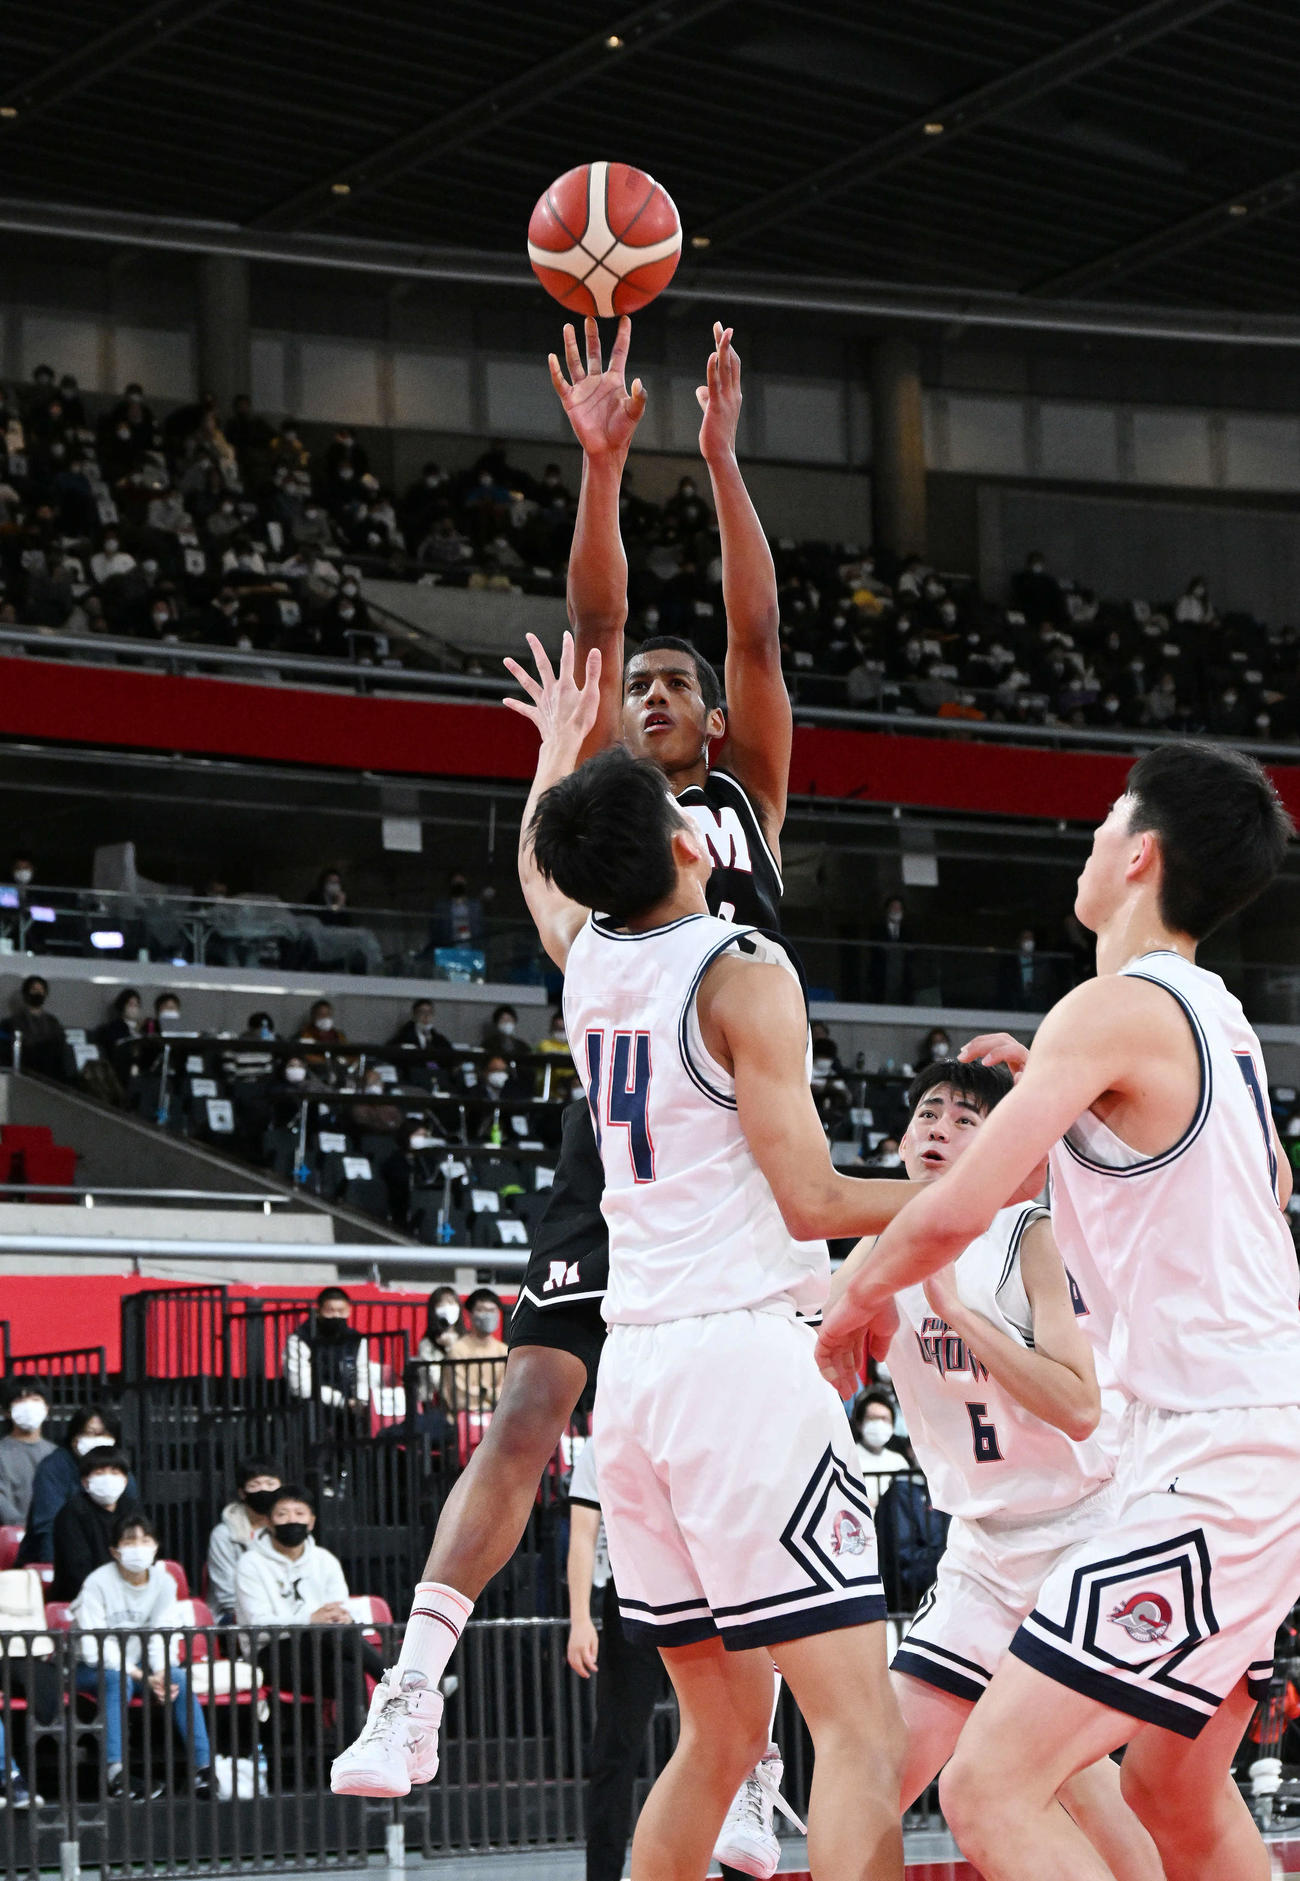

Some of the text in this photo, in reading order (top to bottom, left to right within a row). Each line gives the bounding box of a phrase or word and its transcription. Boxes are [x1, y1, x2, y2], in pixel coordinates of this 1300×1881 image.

[585, 1029, 656, 1184] 14
[542, 1259, 582, 1293] M
[965, 1401, 1005, 1464] 6
